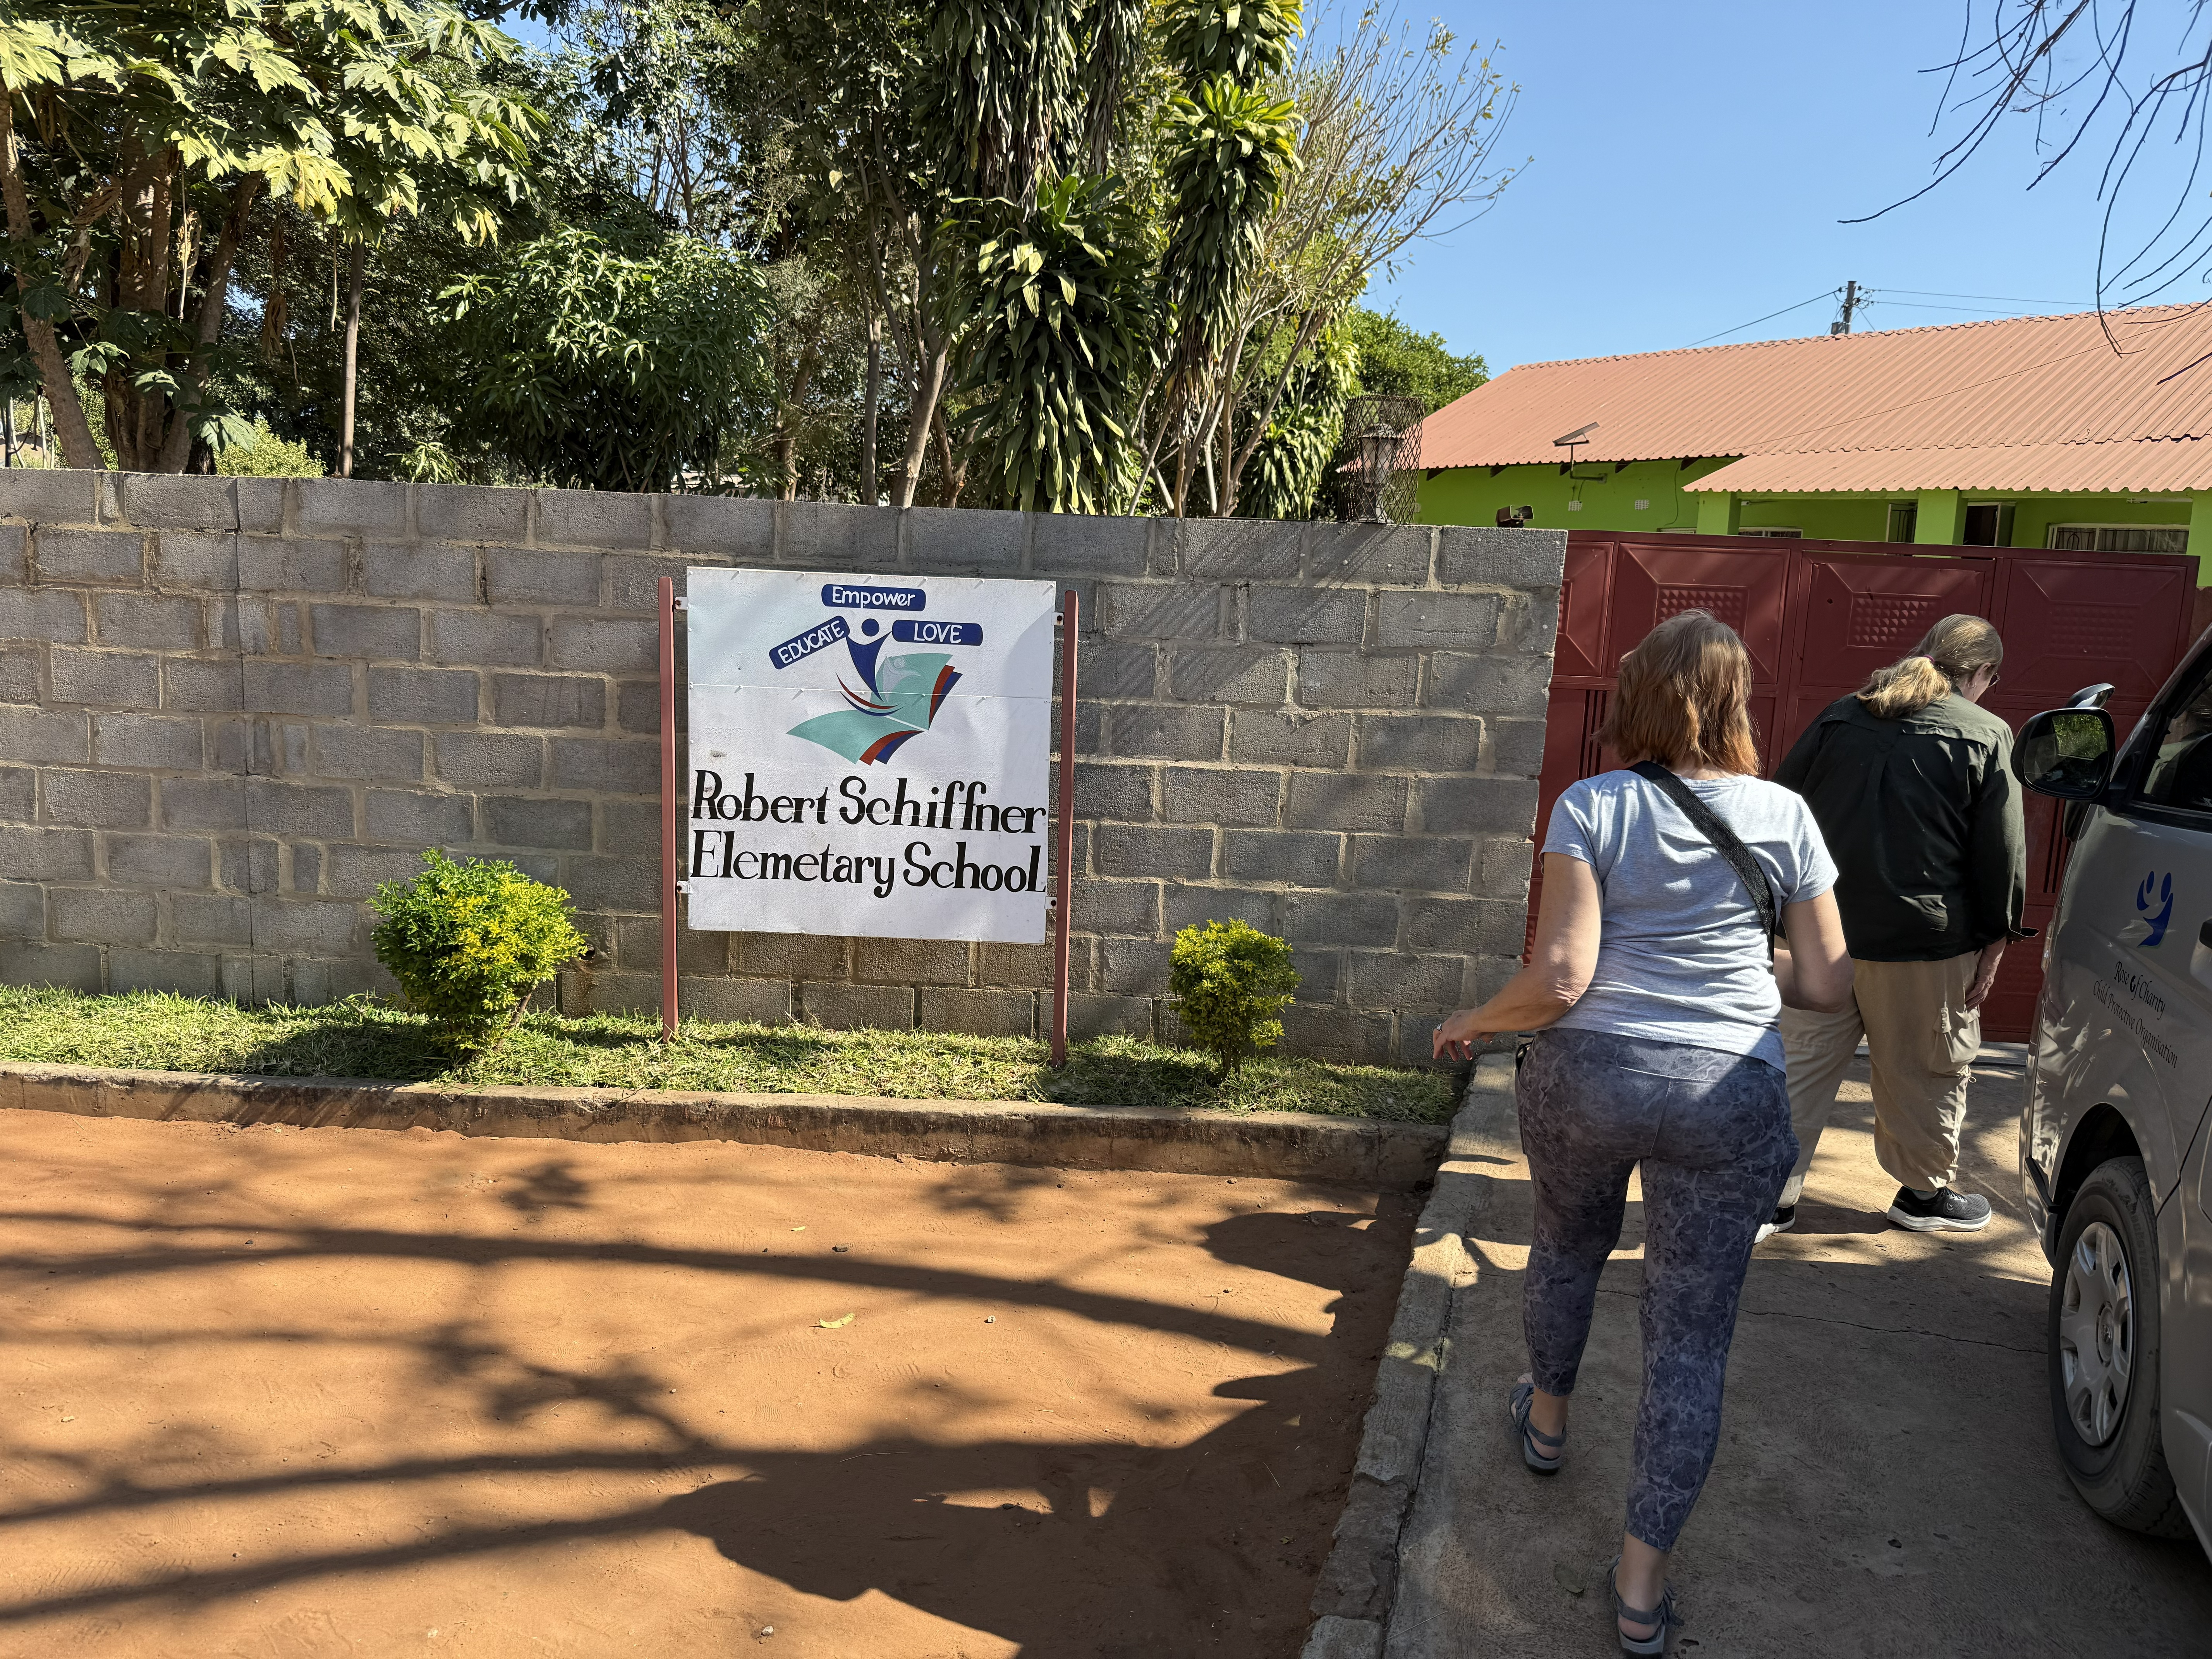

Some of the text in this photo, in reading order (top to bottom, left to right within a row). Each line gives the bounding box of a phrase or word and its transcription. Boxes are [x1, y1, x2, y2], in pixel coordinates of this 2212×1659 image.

[832, 586, 915, 608] Empower
[778, 620, 844, 664] EDUCATE
[914, 622, 963, 643] LOVE
[691, 769, 1046, 833] Robert Schiffner
[690, 830, 895, 898] Elemetary
[2114, 961, 2130, 985] Rose
[2139, 981, 2166, 1020] Charity
[2093, 980, 2178, 1068] Child Protective Organisation
